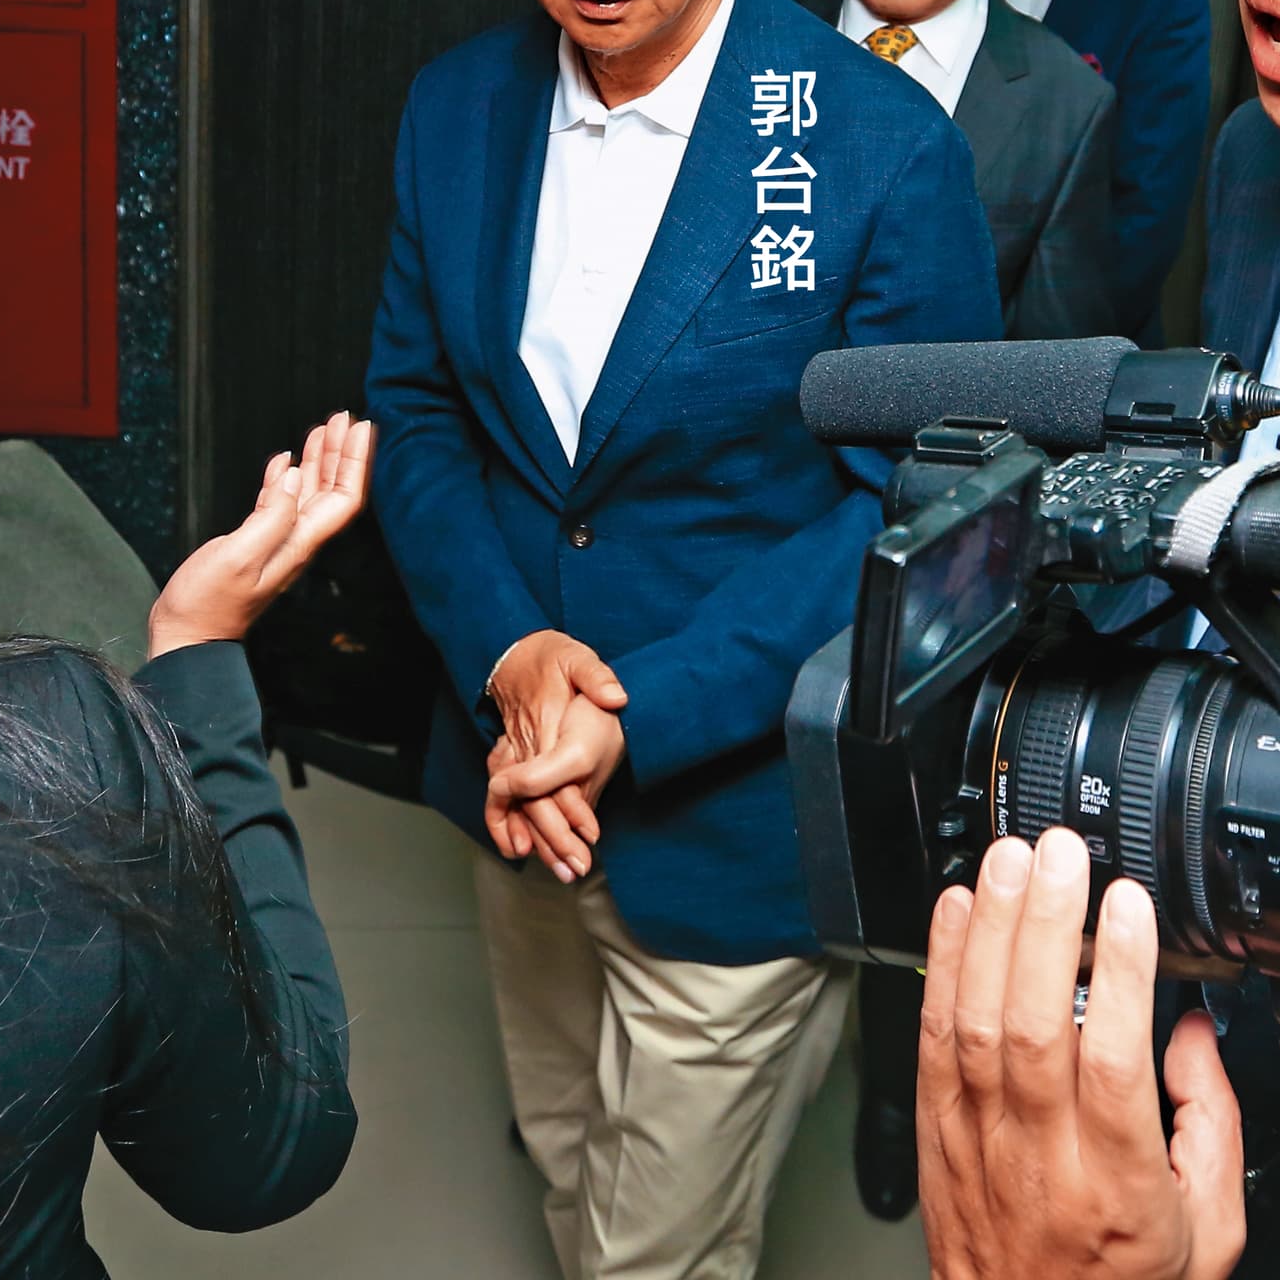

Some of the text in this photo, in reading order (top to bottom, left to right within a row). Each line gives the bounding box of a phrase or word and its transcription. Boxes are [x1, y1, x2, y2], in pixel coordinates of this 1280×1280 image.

[1080, 775, 1111, 797] 20x
[996, 760, 1009, 837] Sony Lens G
[1080, 792, 1110, 807] OPTICAL
[1080, 803, 1100, 815] ZOOM
[1240, 824, 1266, 839] FILTER
